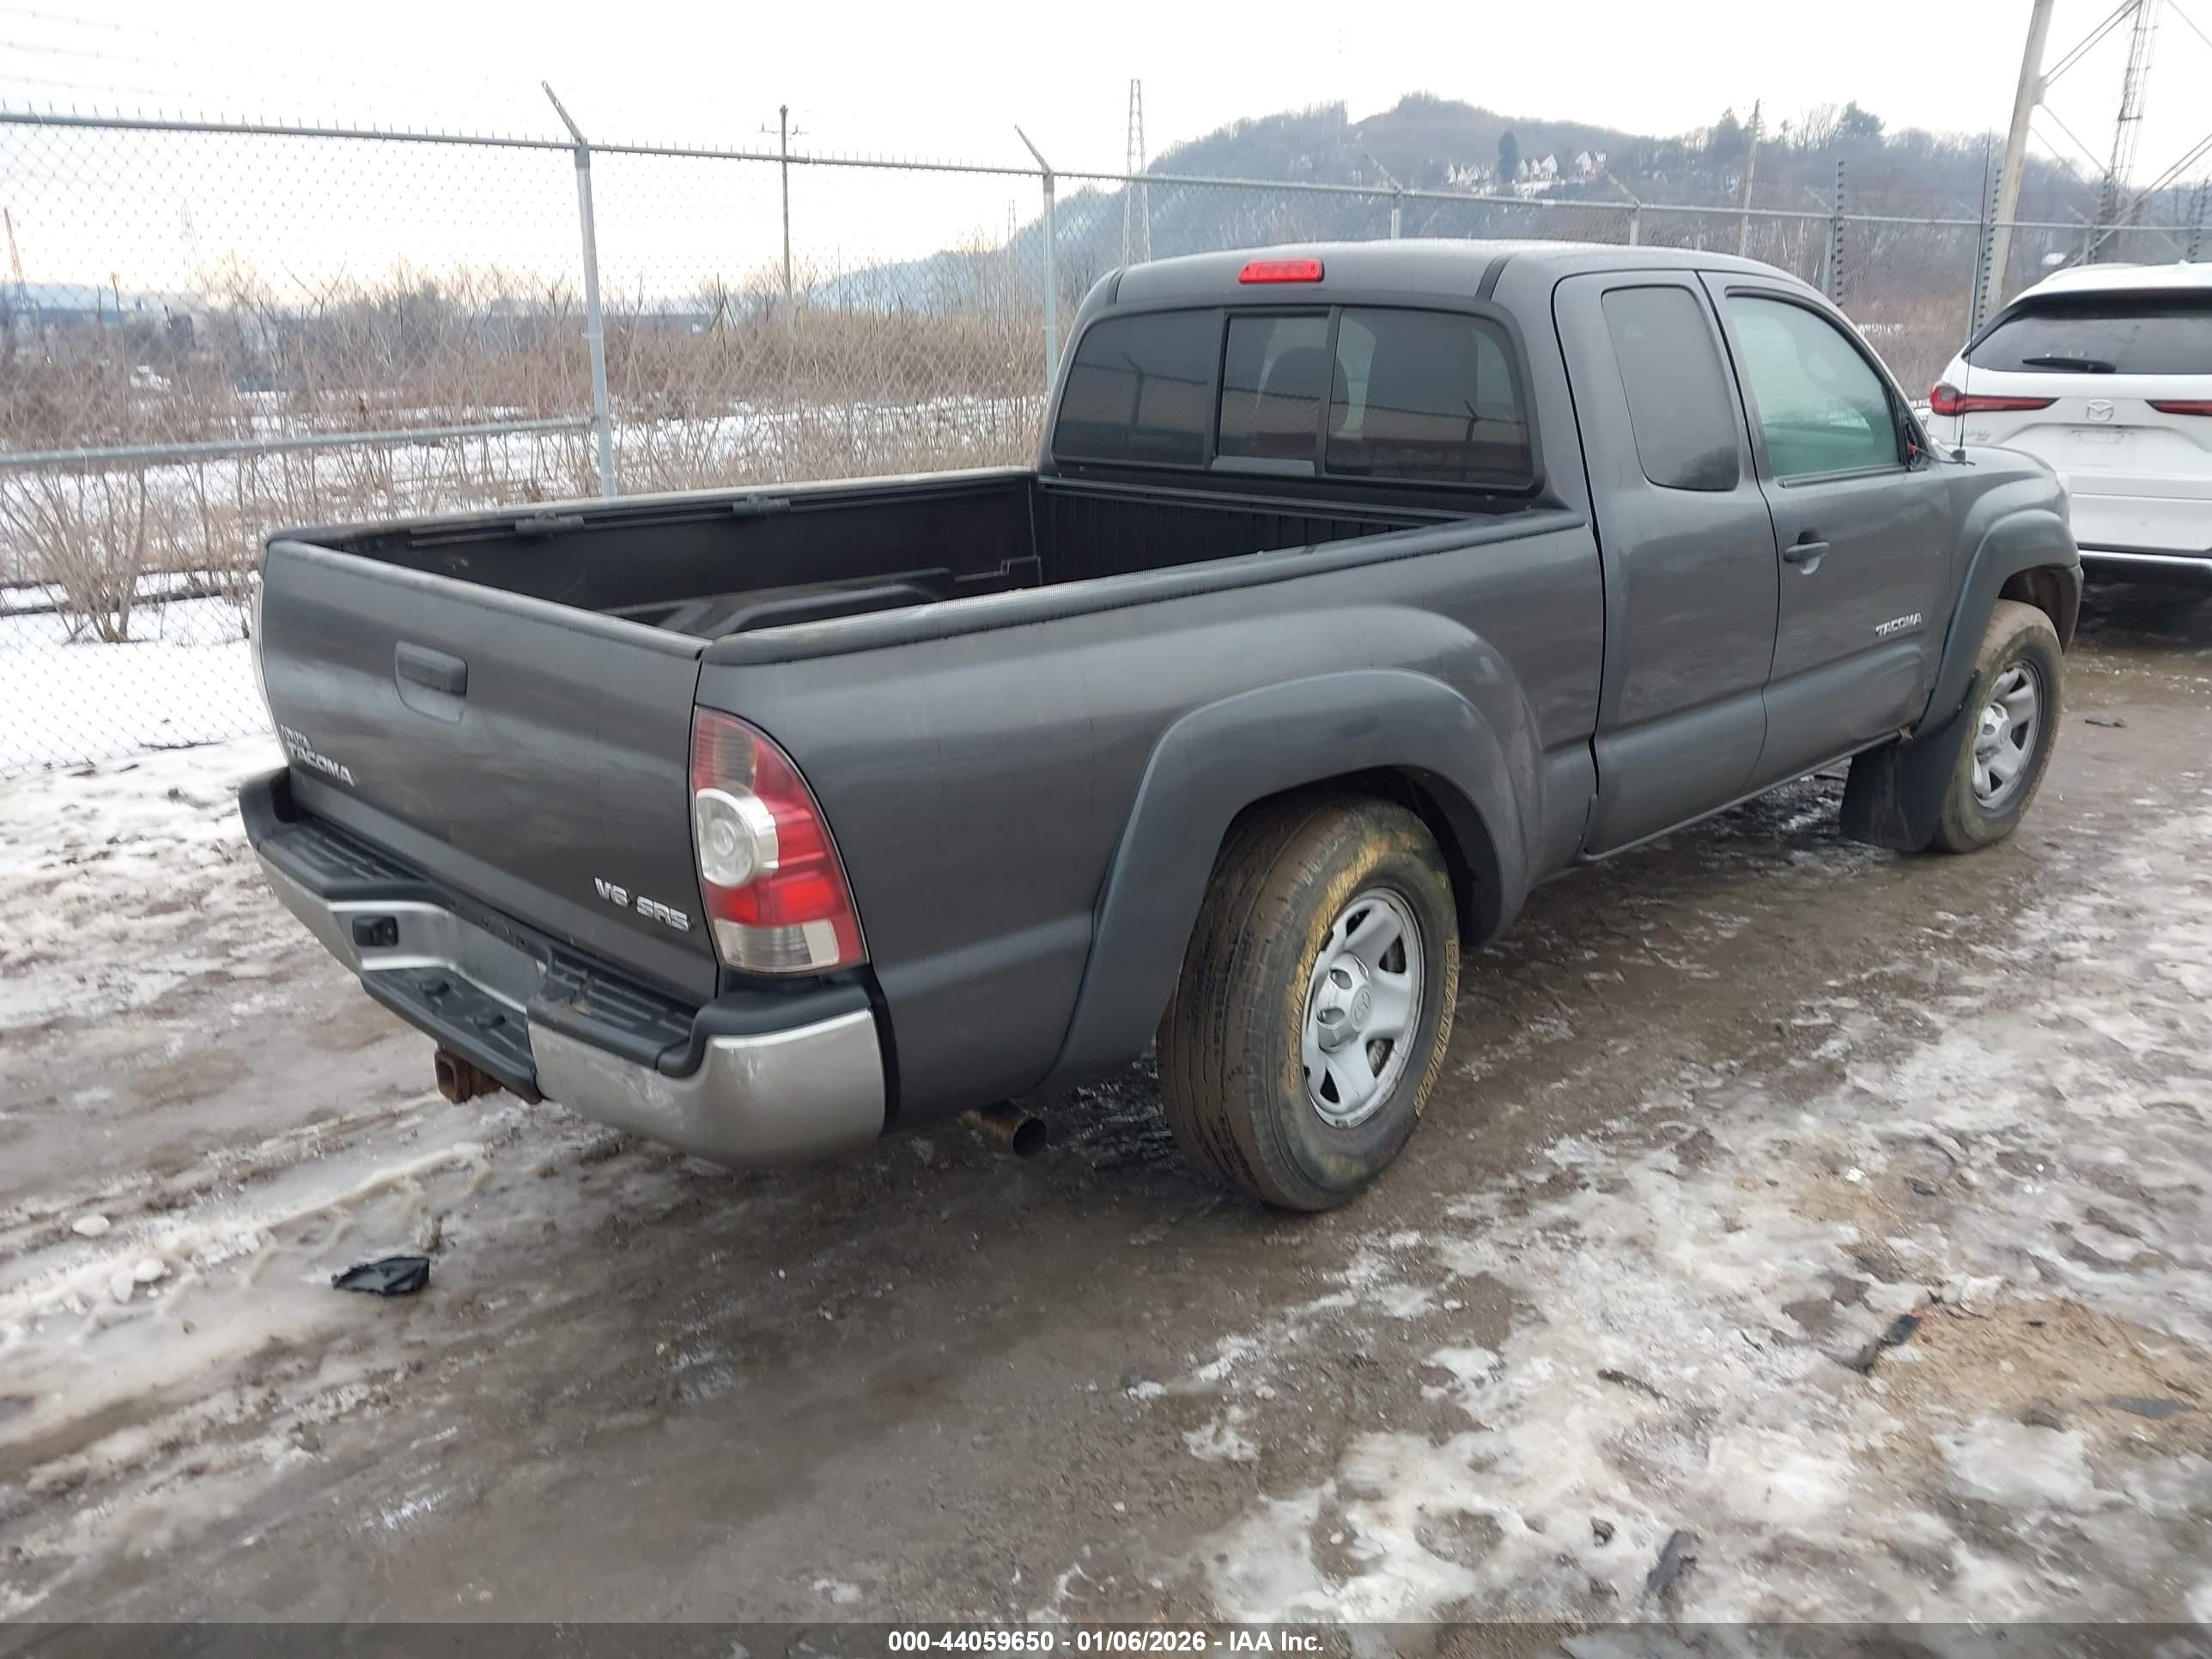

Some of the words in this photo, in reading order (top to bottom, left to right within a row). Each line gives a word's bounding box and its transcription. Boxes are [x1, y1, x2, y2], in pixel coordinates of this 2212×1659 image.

[1875, 611, 1923, 637] TACOMA
[287, 741, 356, 787] TACOMA
[593, 877, 629, 908] V6
[635, 895, 690, 933] SR5
